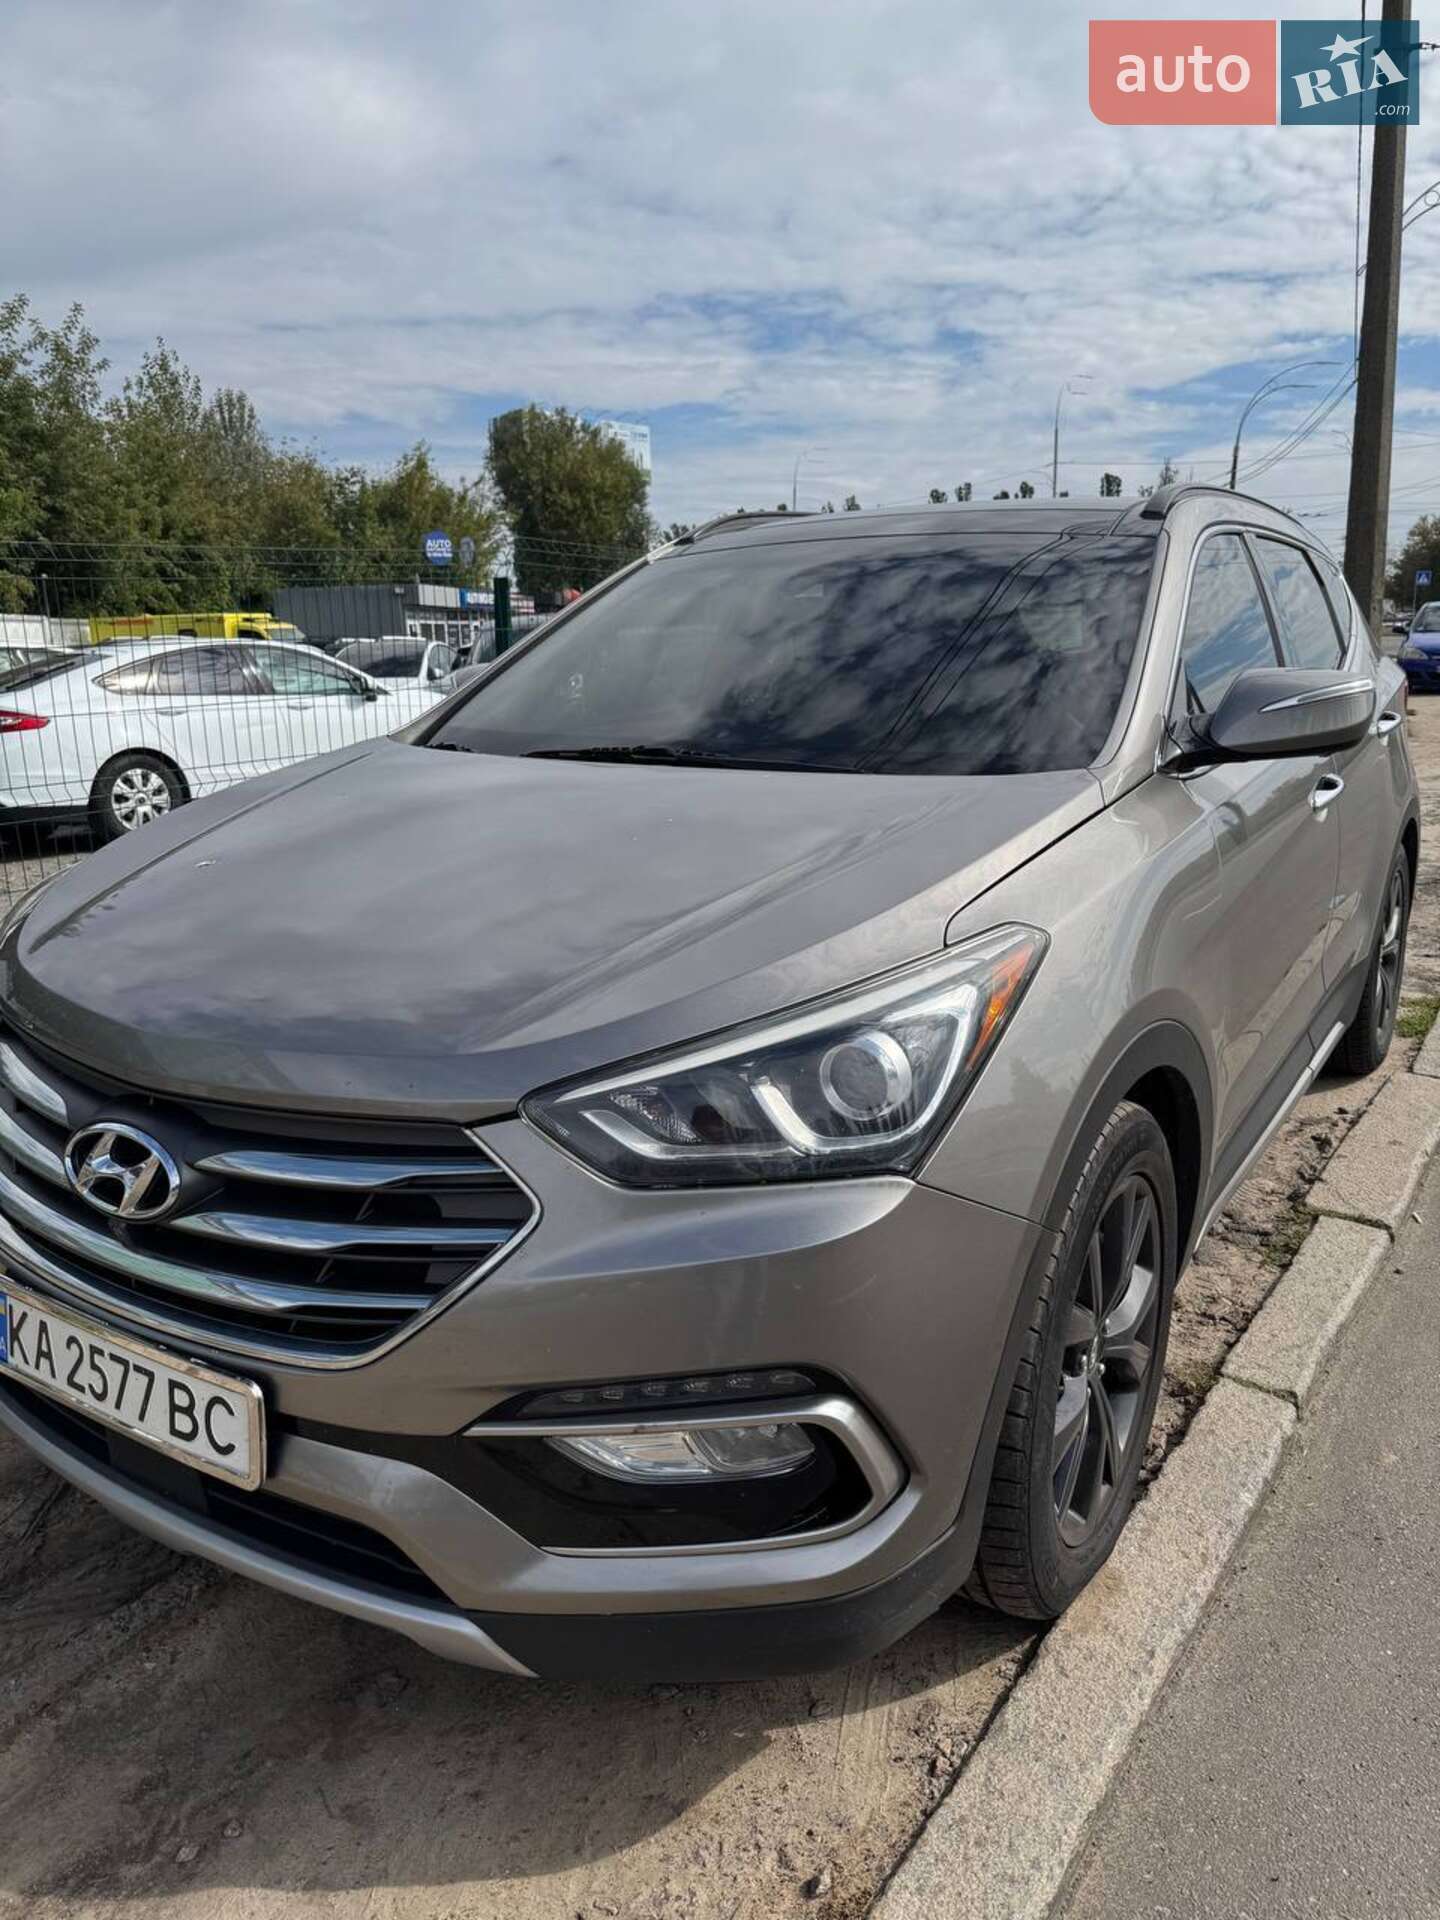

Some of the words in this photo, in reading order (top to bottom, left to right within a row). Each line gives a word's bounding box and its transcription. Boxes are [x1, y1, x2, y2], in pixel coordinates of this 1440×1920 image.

[426, 539, 451, 548] AUTO
[9, 1303, 57, 1379] KA
[66, 1335, 155, 1422] 2577
[168, 1378, 236, 1456] BC
